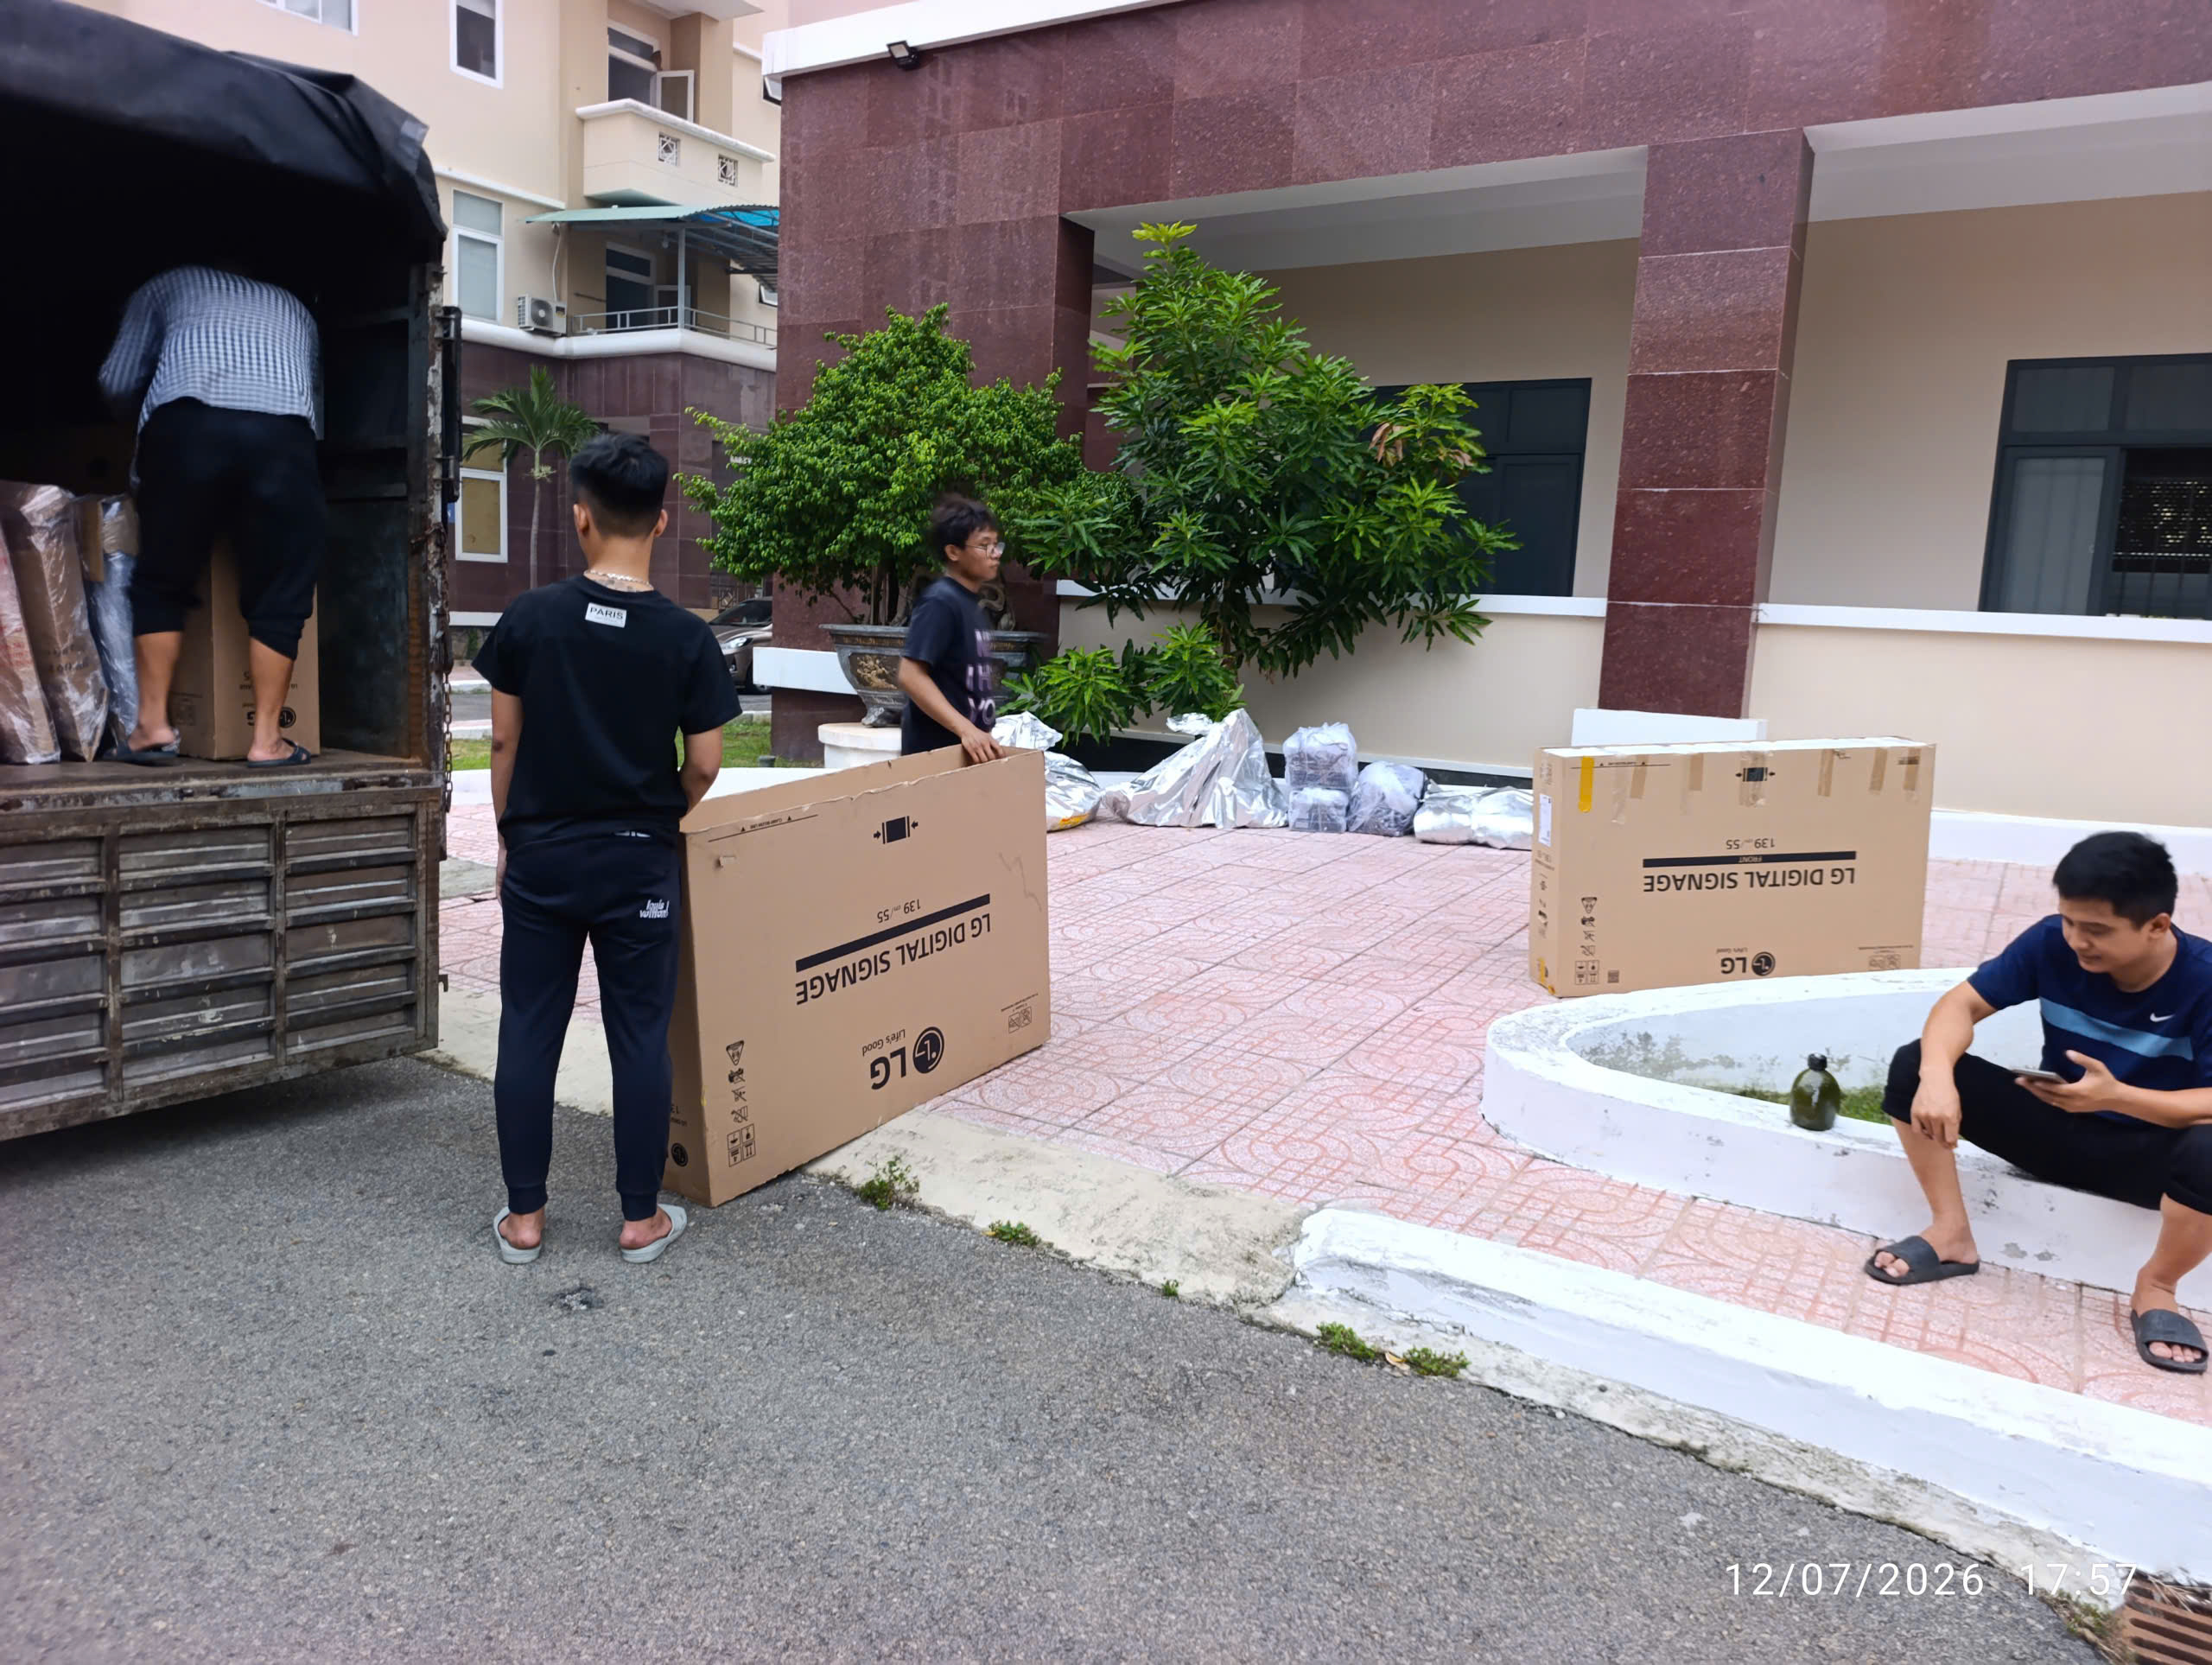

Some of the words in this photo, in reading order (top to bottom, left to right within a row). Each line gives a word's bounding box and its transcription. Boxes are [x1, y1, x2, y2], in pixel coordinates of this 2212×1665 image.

[589, 607, 624, 620] PARIS
[1754, 837, 1776, 849] 139
[1643, 871, 1738, 893] SIGNAGE
[1745, 868, 1824, 888] DIGITAL
[1830, 867, 1855, 884] LG
[903, 899, 921, 914] 139
[970, 912, 991, 934] LG
[895, 922, 965, 966] DIGITAL
[1720, 956, 1747, 975] LG
[795, 950, 892, 1006] SIGNAGE
[861, 1037, 884, 1057] Good
[885, 1028, 906, 1046] Life's
[870, 1046, 907, 1090] LG
